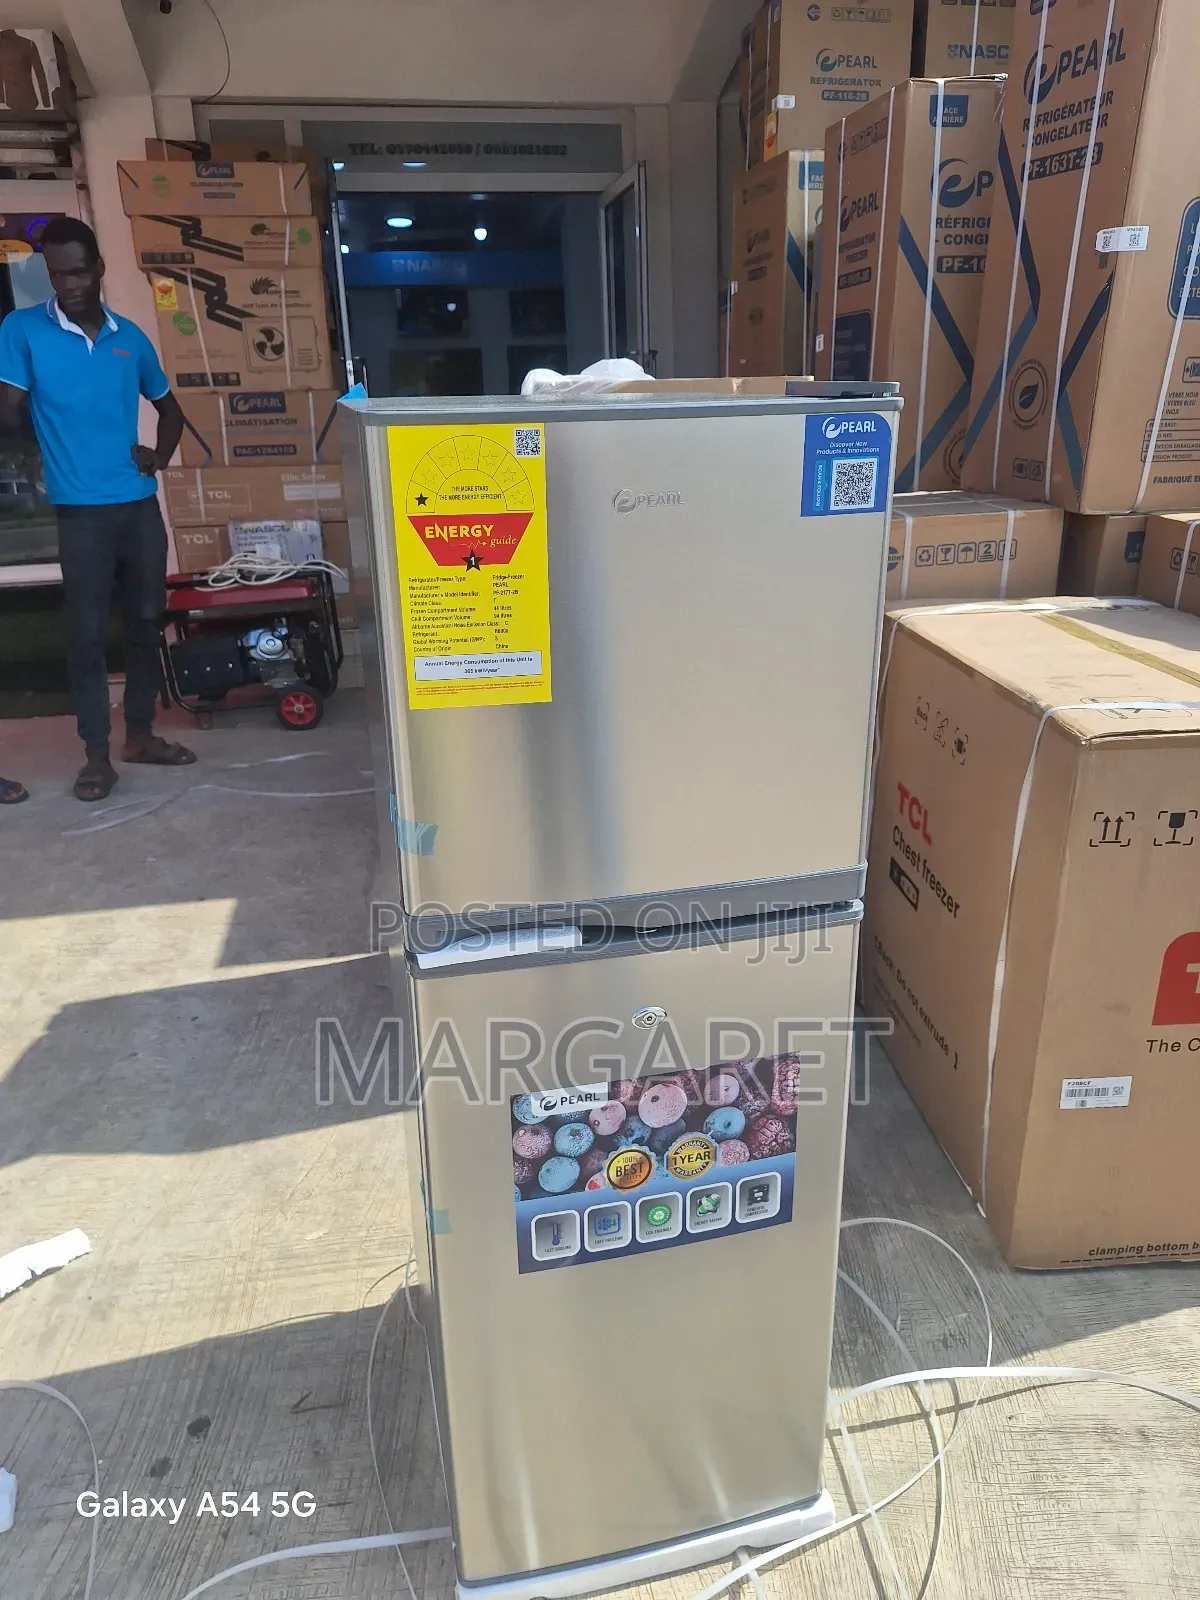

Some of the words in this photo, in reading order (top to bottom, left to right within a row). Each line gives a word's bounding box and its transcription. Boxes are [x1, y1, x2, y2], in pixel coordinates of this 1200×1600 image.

[837, 54, 877, 69] PEARL
[1057, 28, 1126, 84] PEARL
[810, 76, 882, 87] REFRIGERATOR
[933, 115, 964, 123] ARIÈRE
[851, 191, 878, 220] PEARL
[249, 397, 283, 409] PEARL
[225, 418, 298, 428] CLIMATISATION
[841, 420, 877, 434] PEARL
[1153, 474, 1192, 484] FABRIQUÉ
[207, 490, 232, 500] TCL
[637, 491, 685, 507] PEARL
[424, 521, 494, 543] ENERGY
[182, 534, 214, 545] TCL
[490, 534, 517, 548] guide
[470, 556, 476, 566] 1
[463, 658, 499, 666] Consumption
[897, 781, 932, 846] TCL
[892, 825, 921, 873] Chest
[921, 858, 960, 919] freezer
[896, 968, 907, 991] Do
[919, 1006, 949, 1056] extrude
[1146, 1038, 1182, 1053] The
[560, 1091, 600, 1106] PEARL
[676, 1140, 708, 1154] WARRANTY
[679, 1151, 711, 1165] YEAR
[615, 1162, 643, 1177] BEST
[675, 1162, 707, 1176] WARRANTY
[554, 1244, 572, 1252] COOLING
[1088, 1244, 1144, 1256] clamping
[1146, 1242, 1189, 1252] bottom
